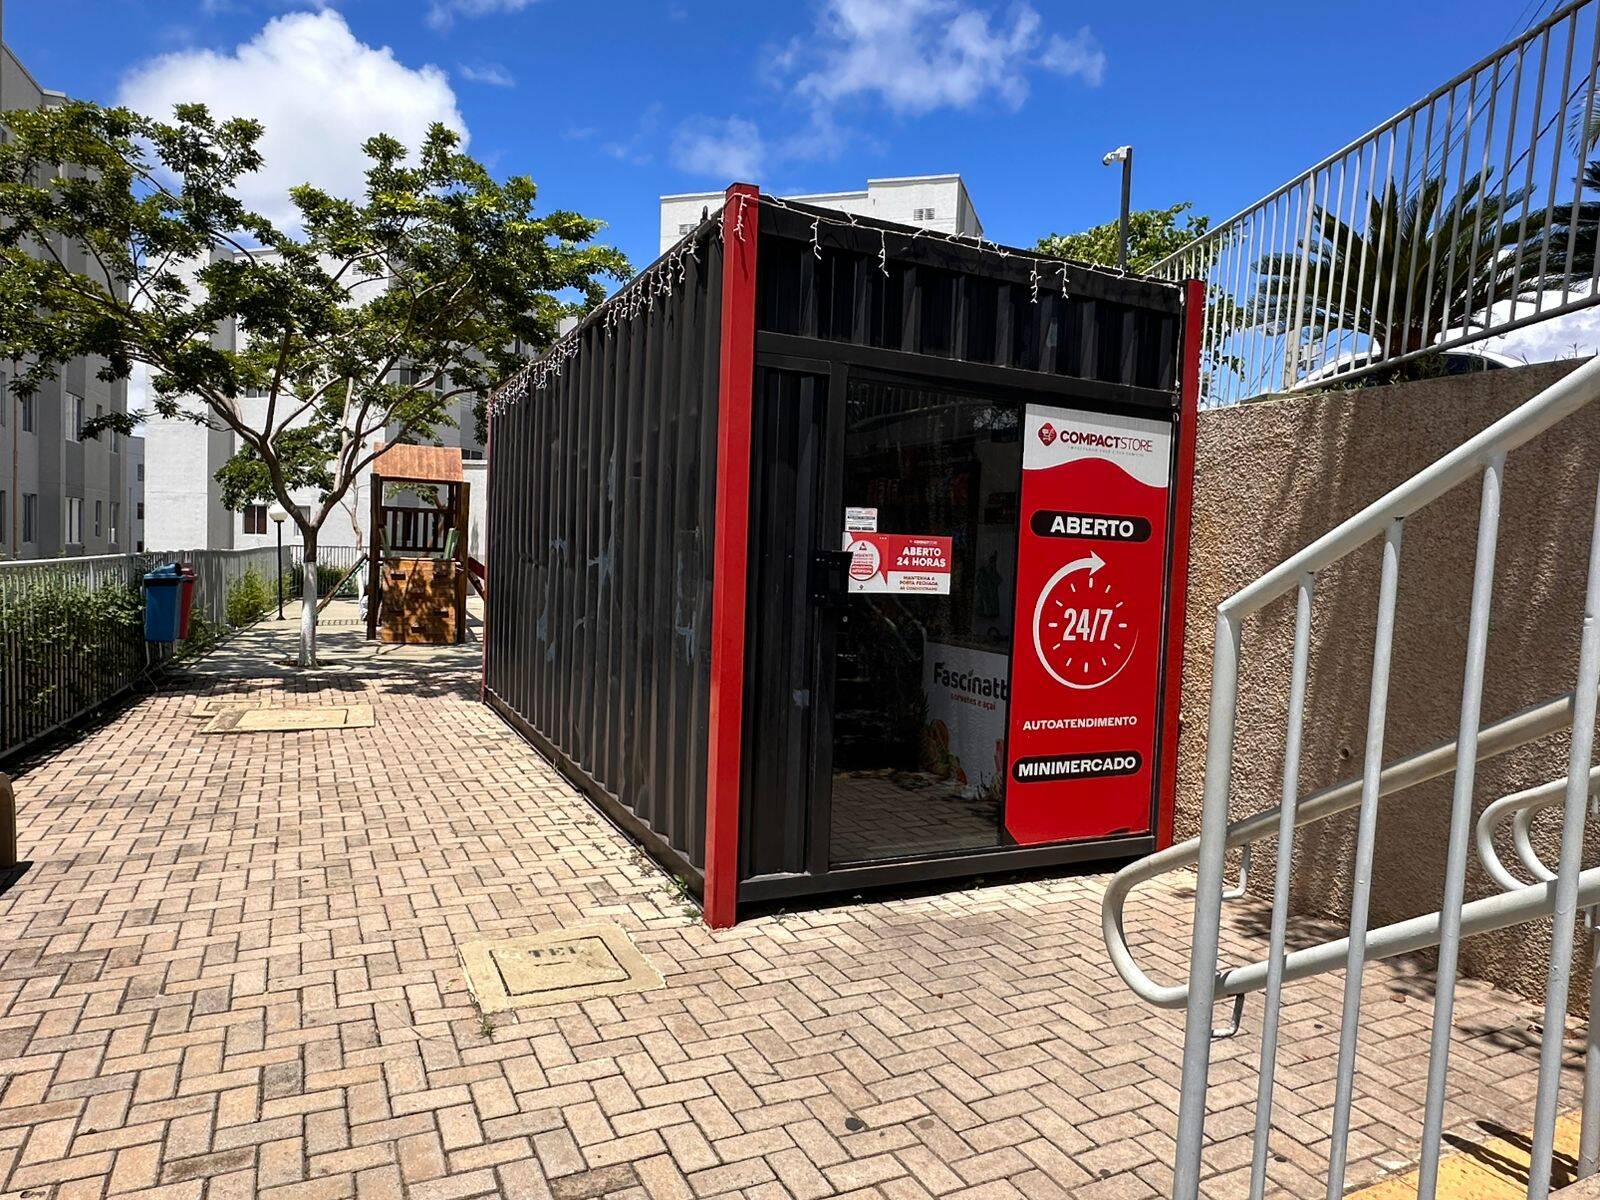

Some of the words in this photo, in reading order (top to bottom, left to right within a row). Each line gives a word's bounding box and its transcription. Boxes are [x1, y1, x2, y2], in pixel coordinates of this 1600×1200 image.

[1060, 430, 1153, 453] COMPACTSTORE
[1050, 515, 1134, 538] ABERTO
[903, 546, 941, 556] ABERTO
[896, 557, 909, 566] 24
[912, 558, 946, 567] HORAS
[1062, 607, 1113, 643] 24/7
[1023, 716, 1138, 731] AUTOATENDIMENTO
[1018, 756, 1136, 777] MINIMERCADO
